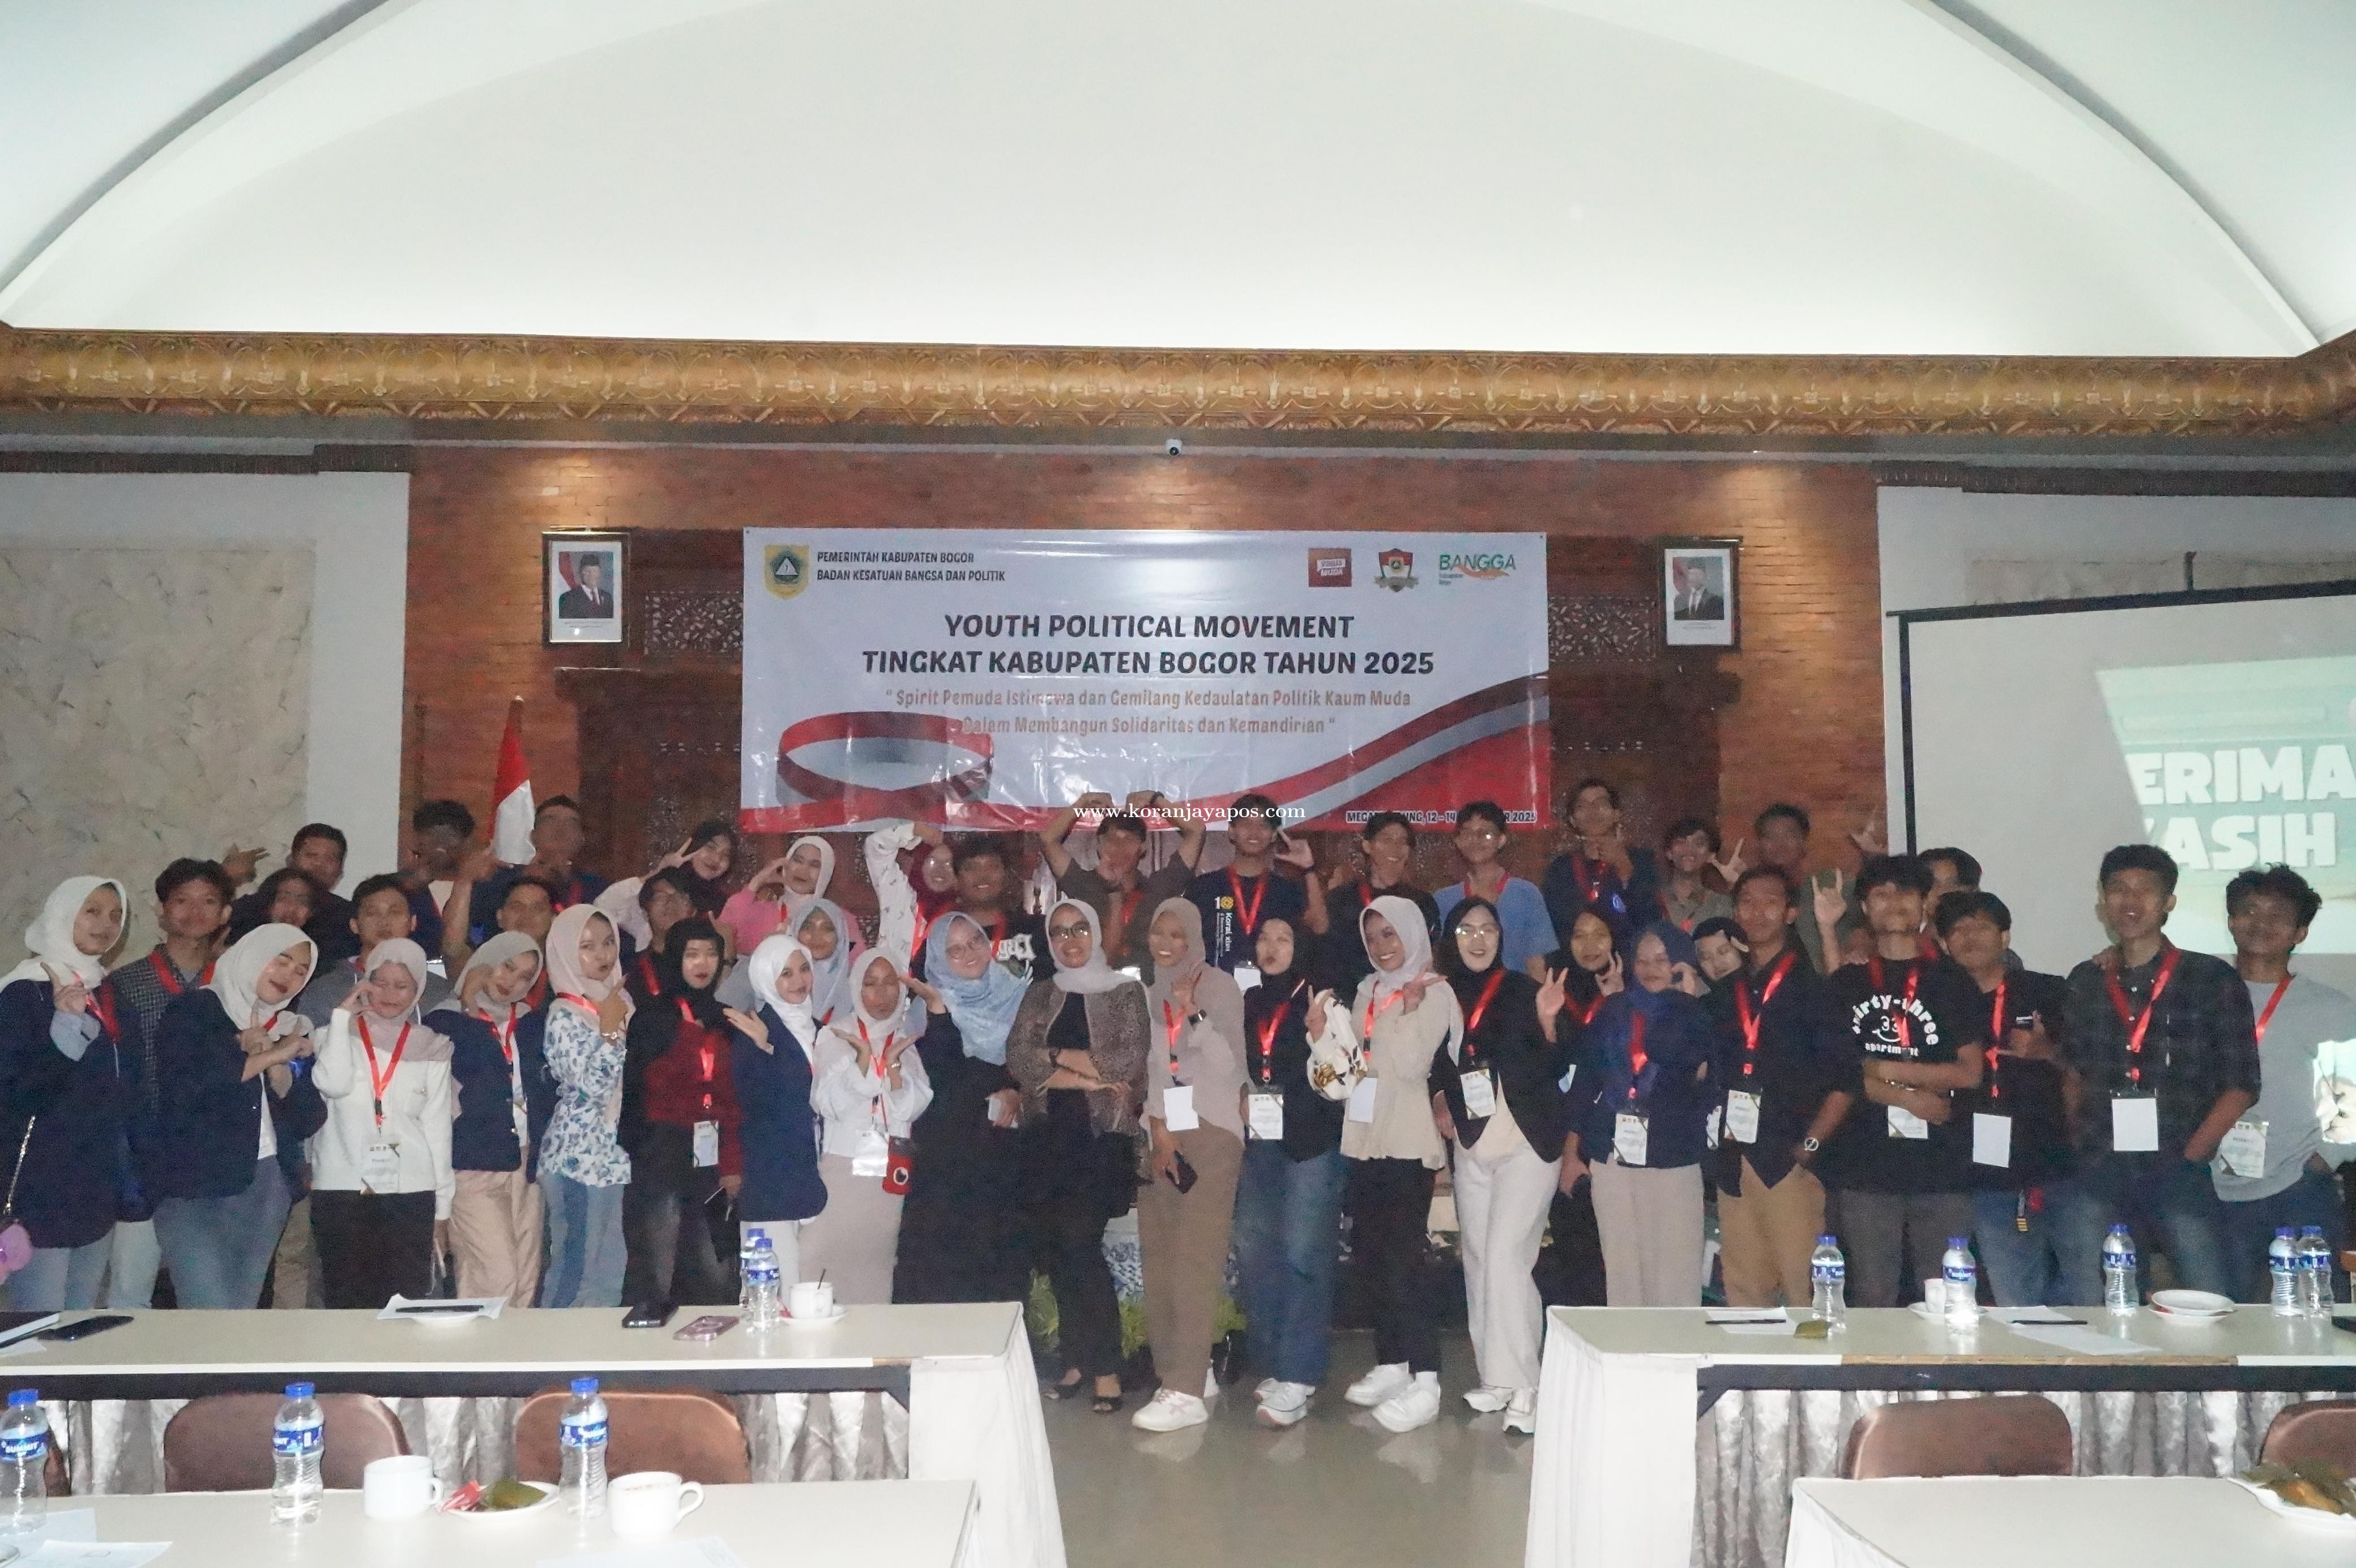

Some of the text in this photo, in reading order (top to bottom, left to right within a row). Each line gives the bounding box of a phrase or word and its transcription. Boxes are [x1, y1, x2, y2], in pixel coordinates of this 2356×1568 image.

[817, 552, 974, 563] PEMERINTAH KABUPATEN BOGOR
[1439, 553, 1517, 570] BANGGA
[817, 570, 1005, 581] BADAN KESATUAN BANGSA DAN POLITIK
[945, 614, 1355, 638] YOUTH POLITICAL MOVEMENT
[862, 650, 1434, 674] TINGKAT KABUPATEN BOGOR TAHUN 2025
[896, 689, 939, 708] Spirit
[943, 689, 1002, 706] Pemuda
[1079, 689, 1106, 706] dan
[1110, 689, 1181, 710] Gemilang
[1184, 689, 1269, 706] Kedaulatan
[1273, 689, 1321, 706] Politik
[1325, 690, 1365, 706] Kaum
[1370, 690, 1411, 706] Muda
[1014, 716, 1107, 737] Membangun
[1111, 716, 1193, 734] Solidaritas
[1198, 717, 1225, 733] dan
[1229, 716, 1325, 734] Kemandirian
[1427, 811, 1437, 822] 12
[2144, 812, 2336, 870] ASIH
